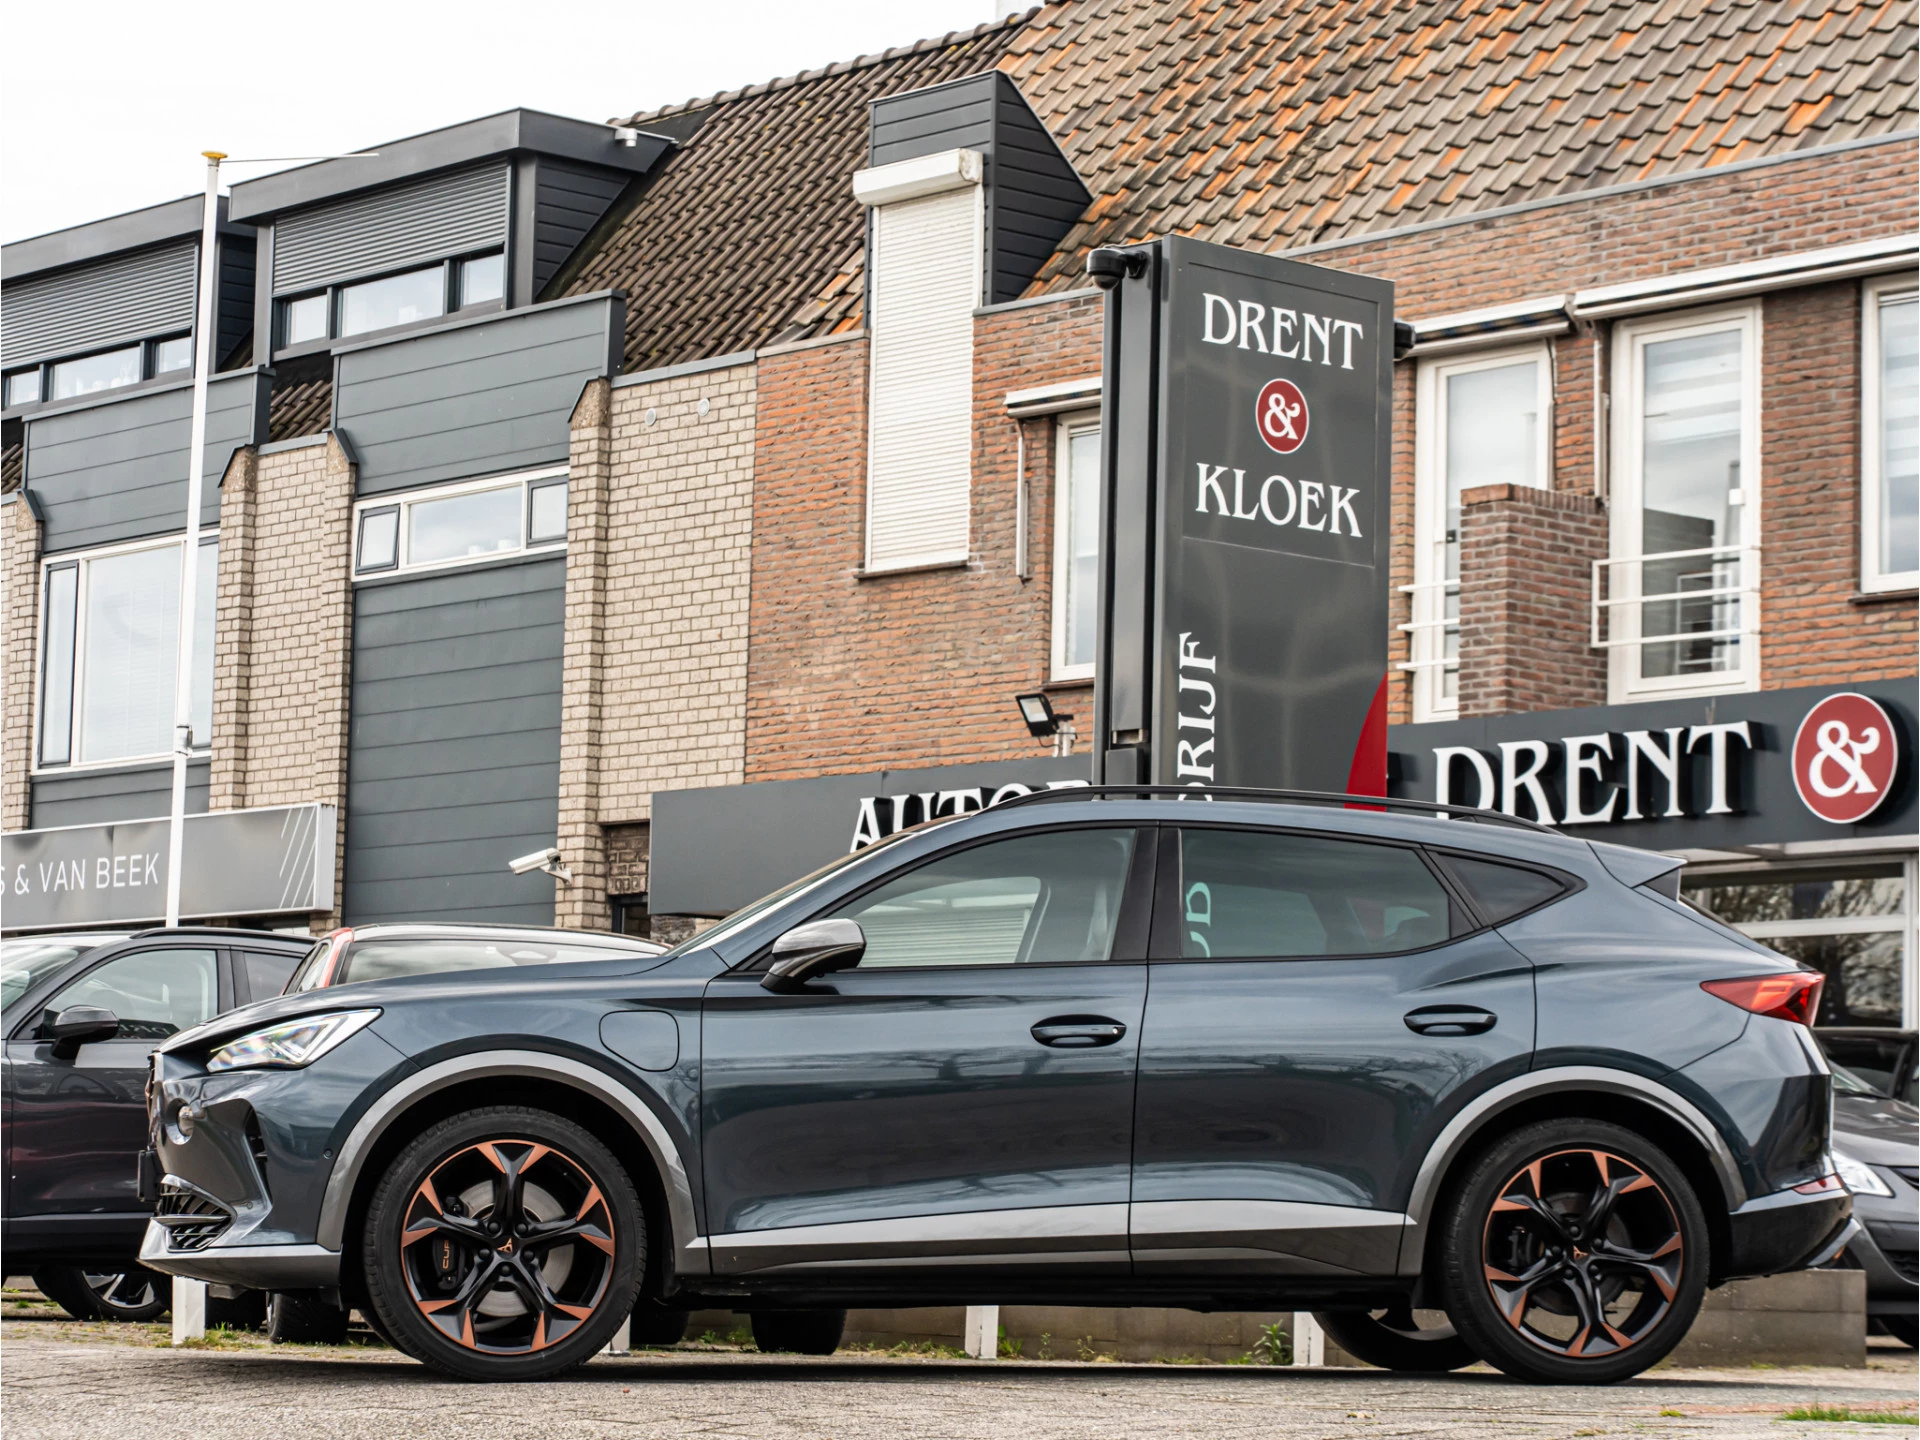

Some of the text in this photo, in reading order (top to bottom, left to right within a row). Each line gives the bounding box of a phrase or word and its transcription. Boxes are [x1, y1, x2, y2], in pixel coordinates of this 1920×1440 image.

[1201, 292, 1364, 370] DRENT
[1264, 393, 1301, 440] &
[1195, 462, 1363, 538] KLOEK
[1432, 719, 1881, 826] DRENT &
[14, 863, 30, 896] &
[39, 858, 86, 894] VAN
[95, 852, 160, 890] BEEK
